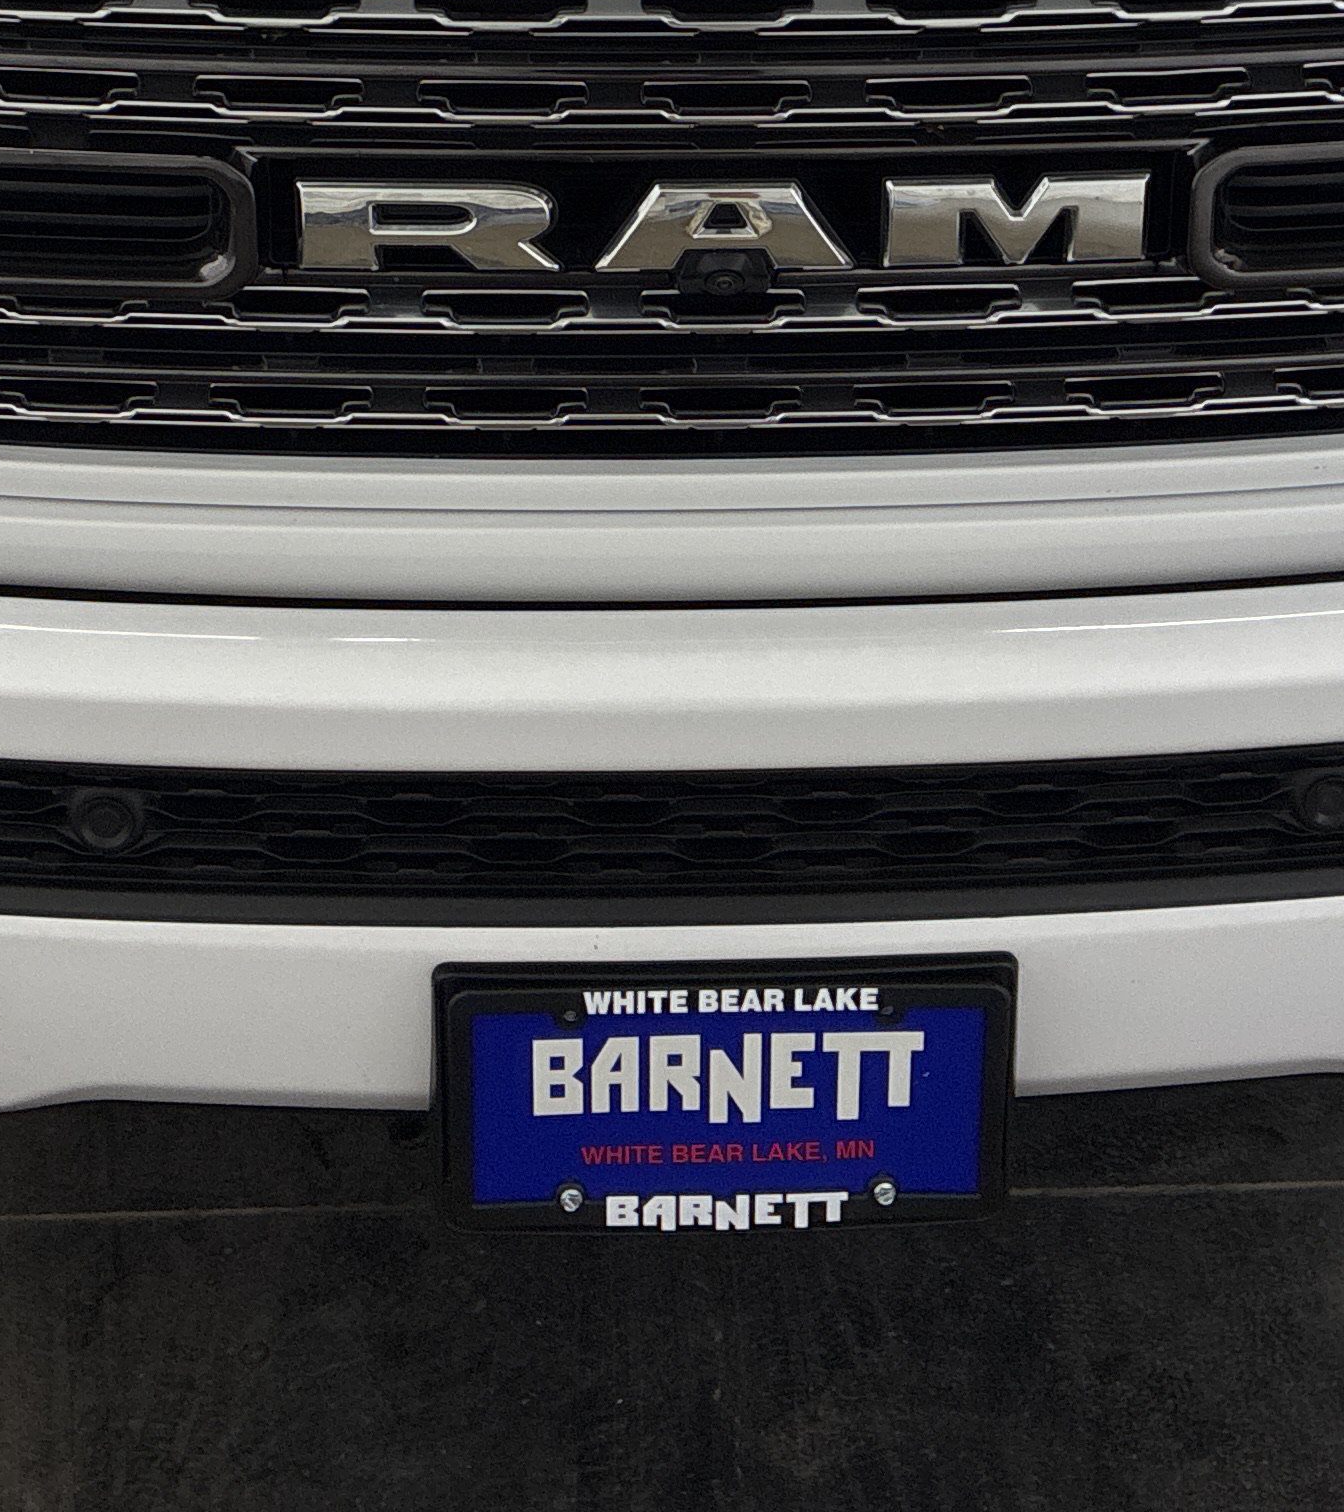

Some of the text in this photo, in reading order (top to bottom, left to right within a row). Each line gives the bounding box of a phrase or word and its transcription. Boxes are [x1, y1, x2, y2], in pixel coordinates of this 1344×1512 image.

[296, 175, 1151, 271] RAM
[585, 988, 879, 1014] WHITE BEAR LAKE
[533, 1032, 924, 1123] BARNETT
[581, 1140, 874, 1165] WHITE BEAR LAKE, MN
[606, 1193, 848, 1231] BARNETT
